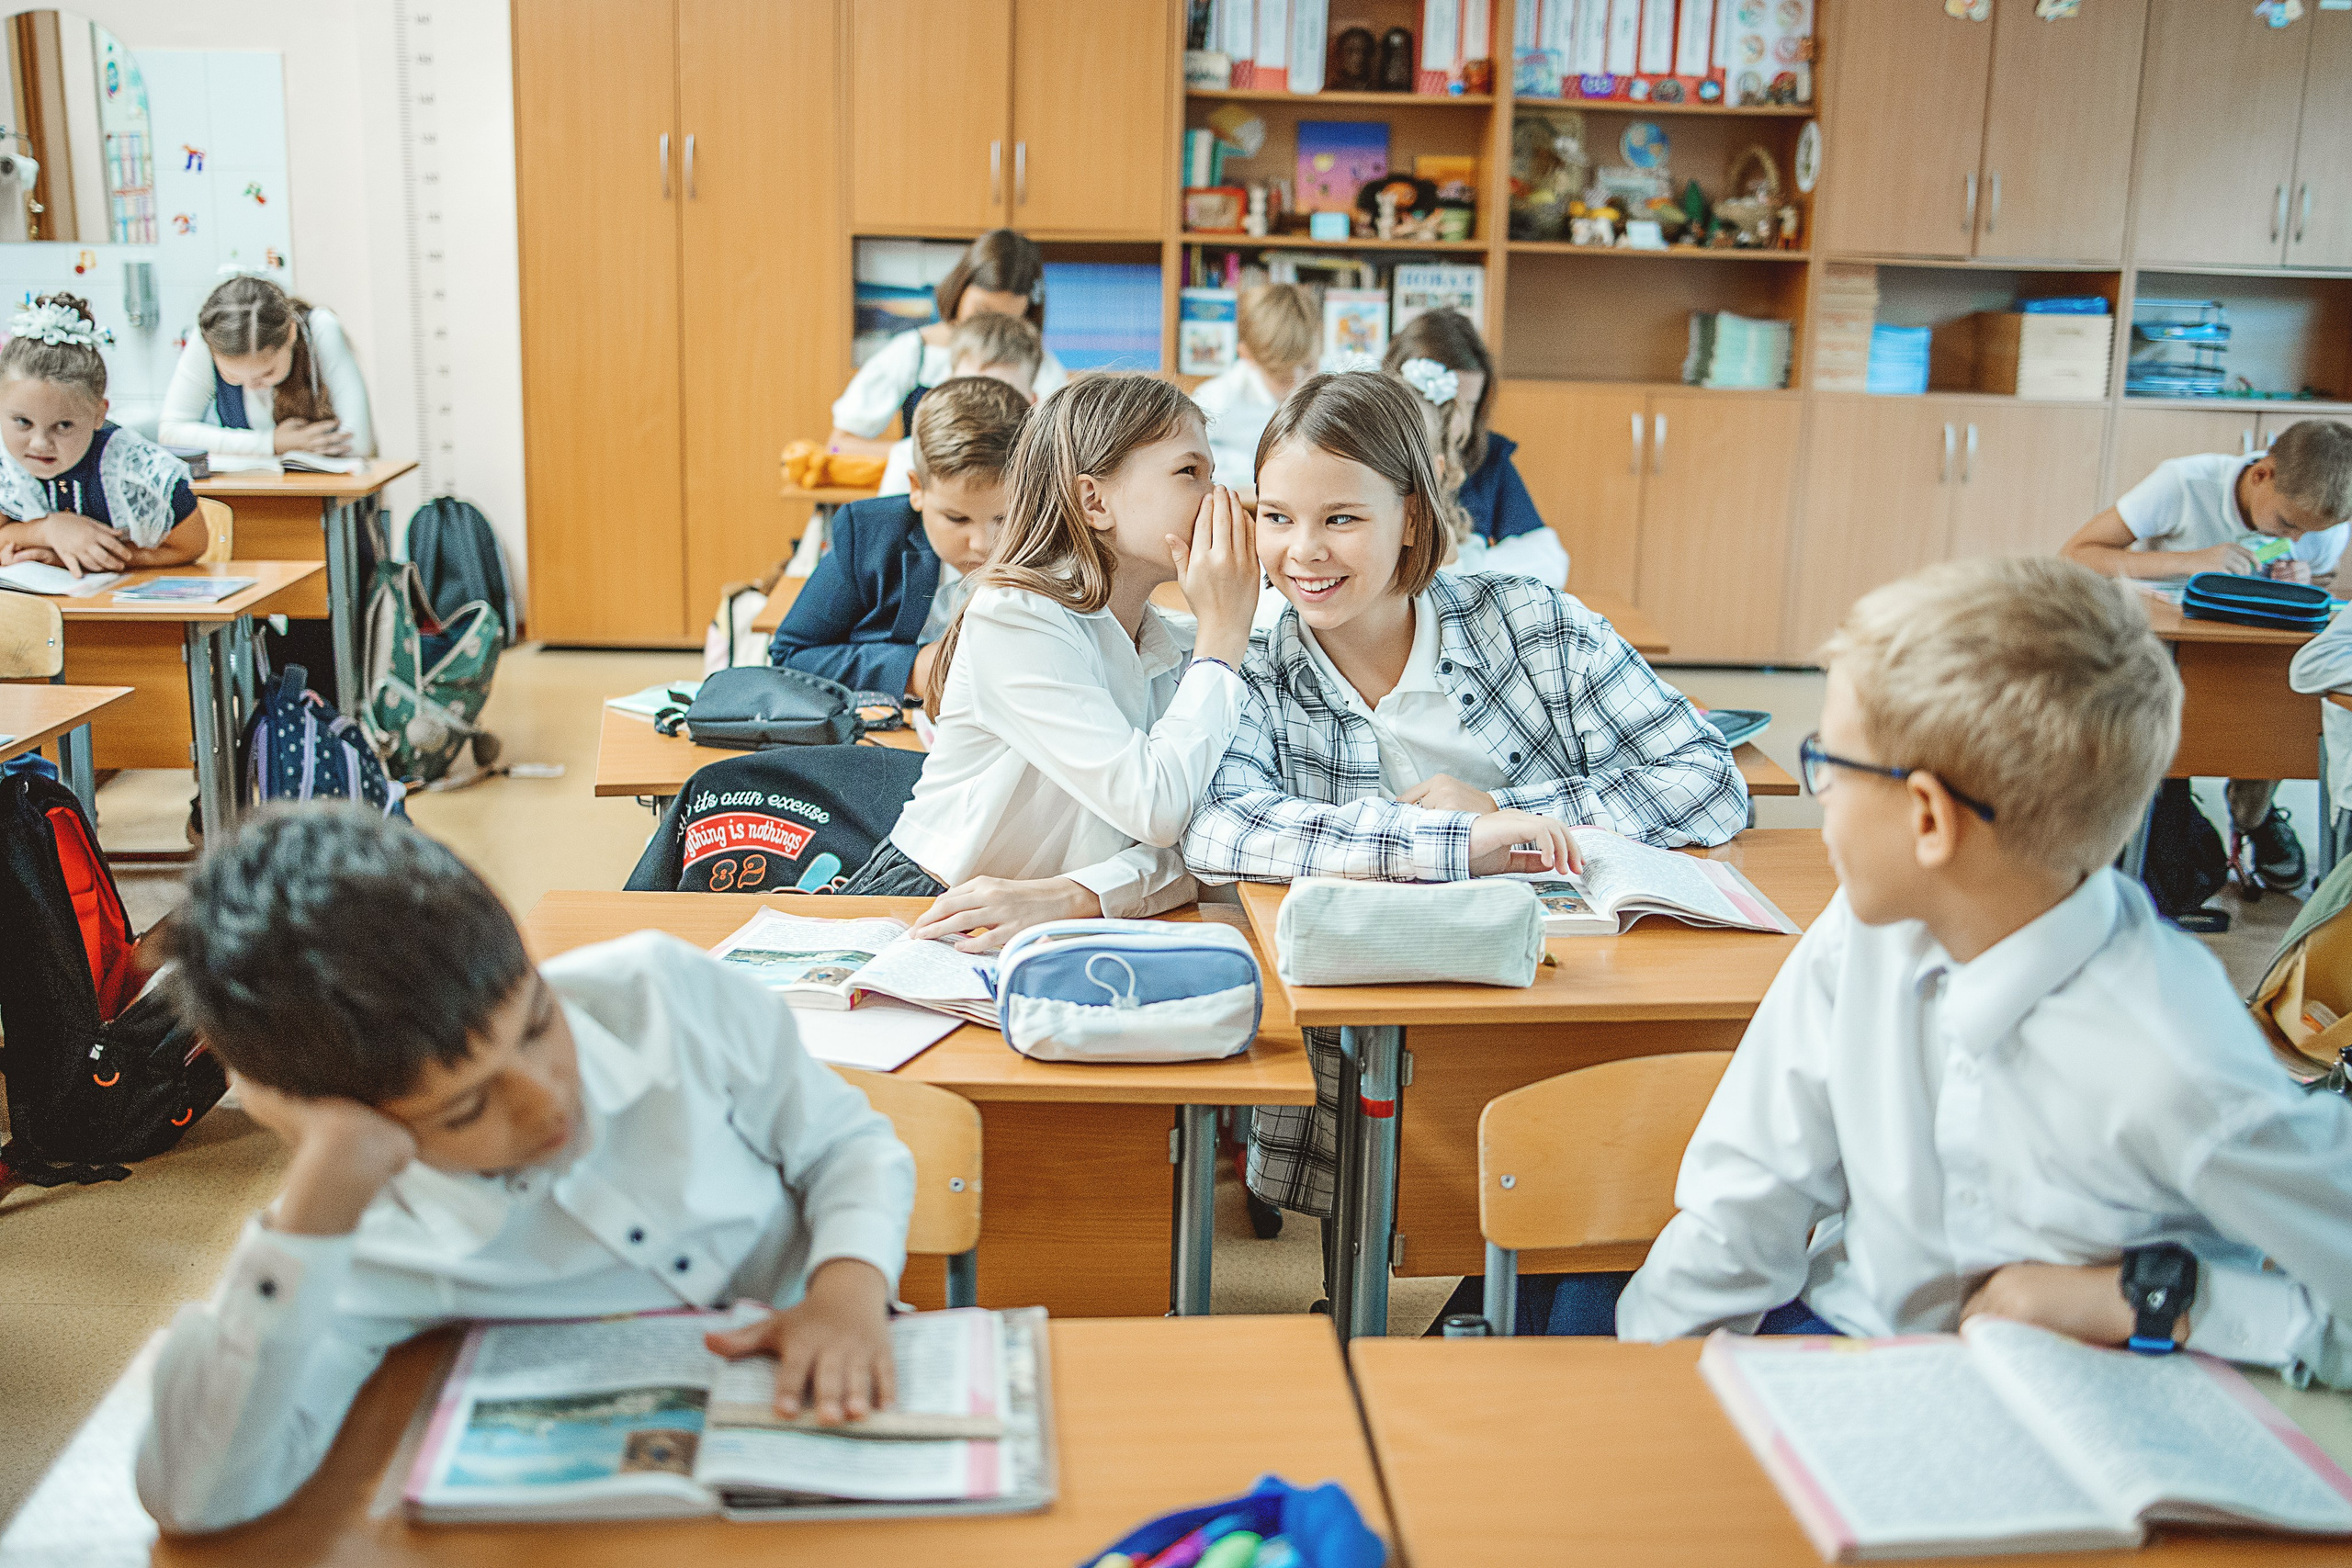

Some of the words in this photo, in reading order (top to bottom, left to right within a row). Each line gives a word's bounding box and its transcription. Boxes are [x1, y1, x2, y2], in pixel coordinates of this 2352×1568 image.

[767, 794, 830, 824] excuse
[729, 818, 744, 840] is
[749, 820, 802, 853] nothings
